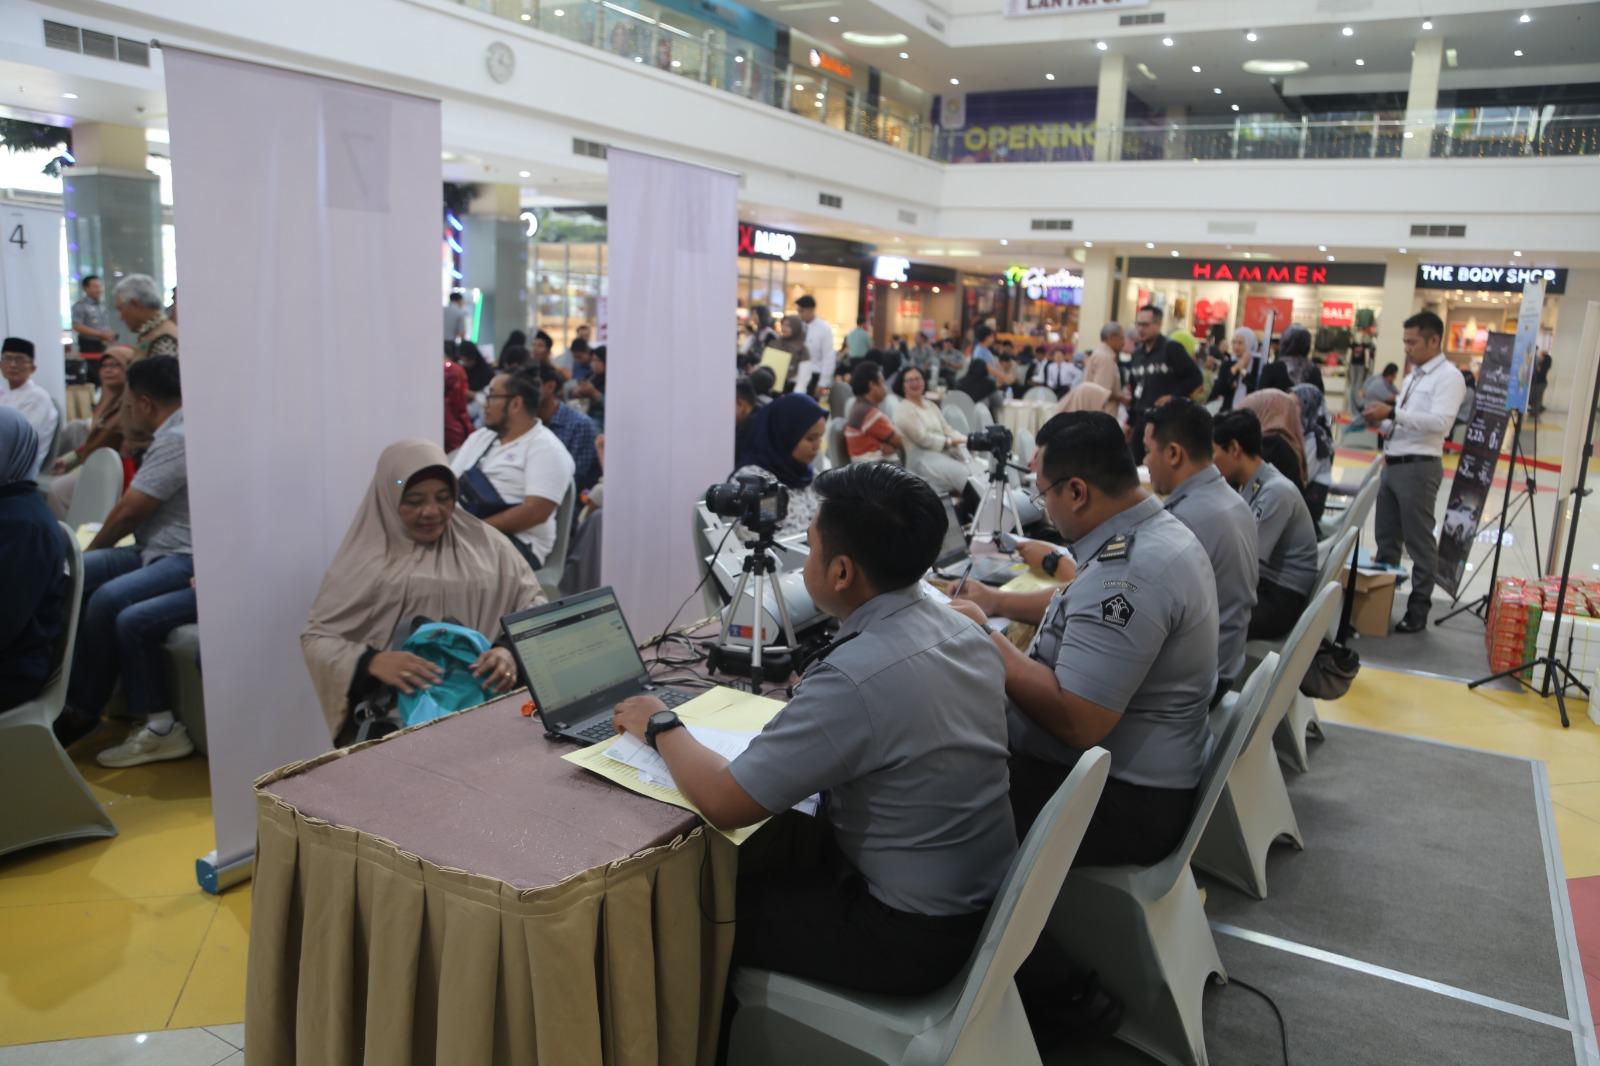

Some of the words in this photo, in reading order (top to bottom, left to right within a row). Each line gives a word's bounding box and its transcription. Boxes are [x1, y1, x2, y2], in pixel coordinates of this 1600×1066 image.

[9, 224, 28, 250] 4
[1193, 263, 1328, 284] HAMMER
[1421, 265, 1454, 281] THE
[1457, 267, 1504, 283] BODY
[1323, 306, 1352, 320] SALE
